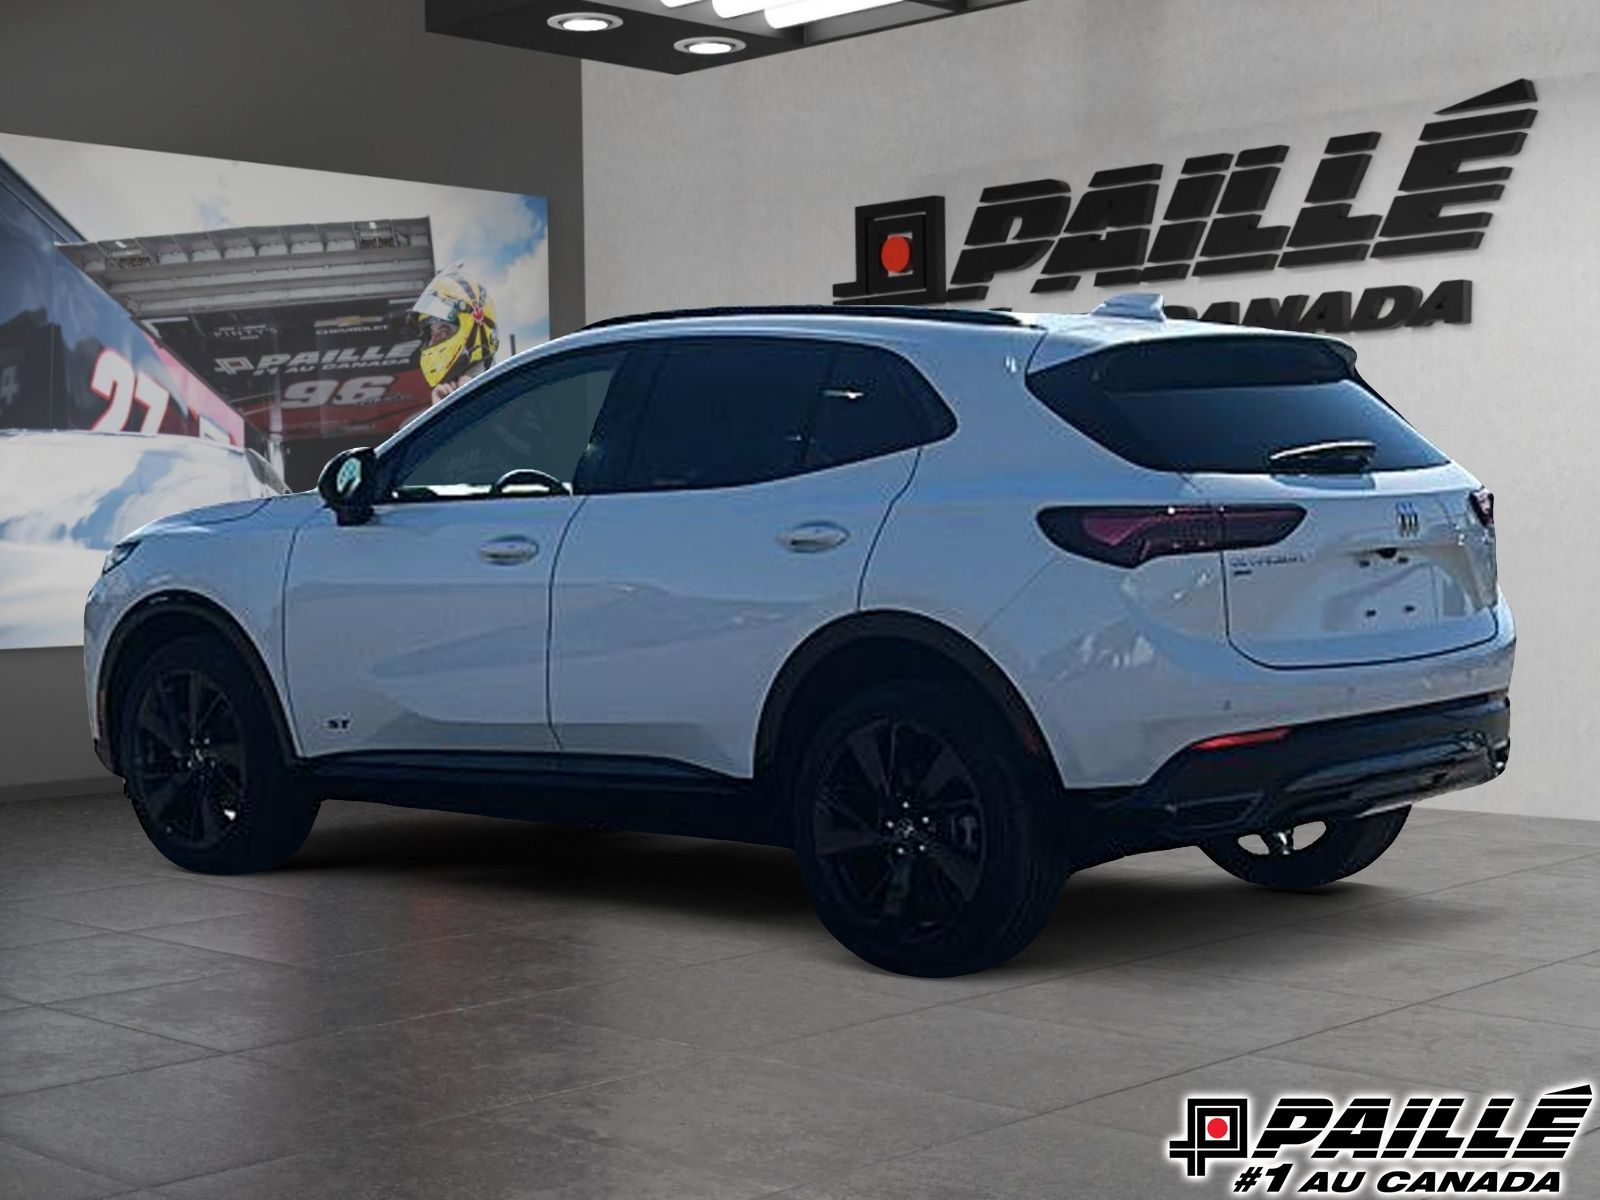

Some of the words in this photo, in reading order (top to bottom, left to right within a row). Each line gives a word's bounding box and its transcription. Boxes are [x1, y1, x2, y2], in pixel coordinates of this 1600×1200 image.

[946, 78, 1538, 300] PAILLÉ
[1163, 279, 1473, 332] NADA
[315, 324, 389, 335] CHEVROLET
[285, 365, 315, 374] AU
[321, 357, 411, 371] CANADA
[89, 348, 170, 436] 27
[281, 375, 394, 409] 96
